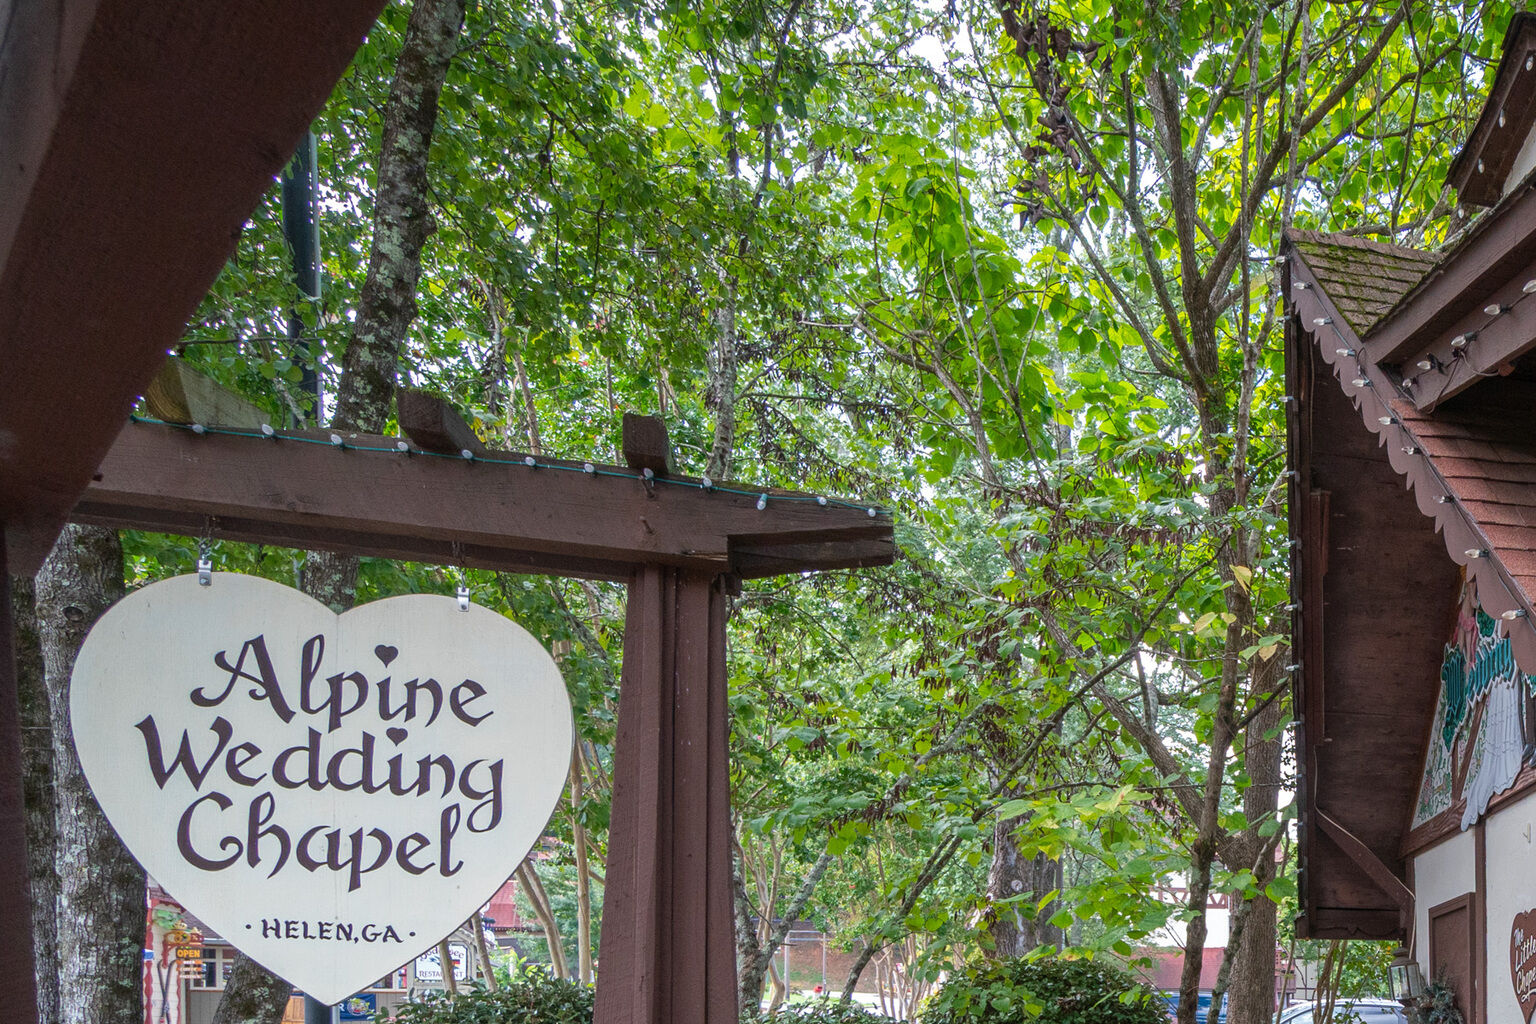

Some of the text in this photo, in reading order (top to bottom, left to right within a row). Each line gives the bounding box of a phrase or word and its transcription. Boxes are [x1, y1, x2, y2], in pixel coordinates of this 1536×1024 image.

[190, 634, 494, 729] Alpine
[135, 716, 504, 833] Wedding
[176, 791, 464, 892] Chapel
[177, 949, 200, 958] OPEN
[1515, 935, 1536, 973] Little
